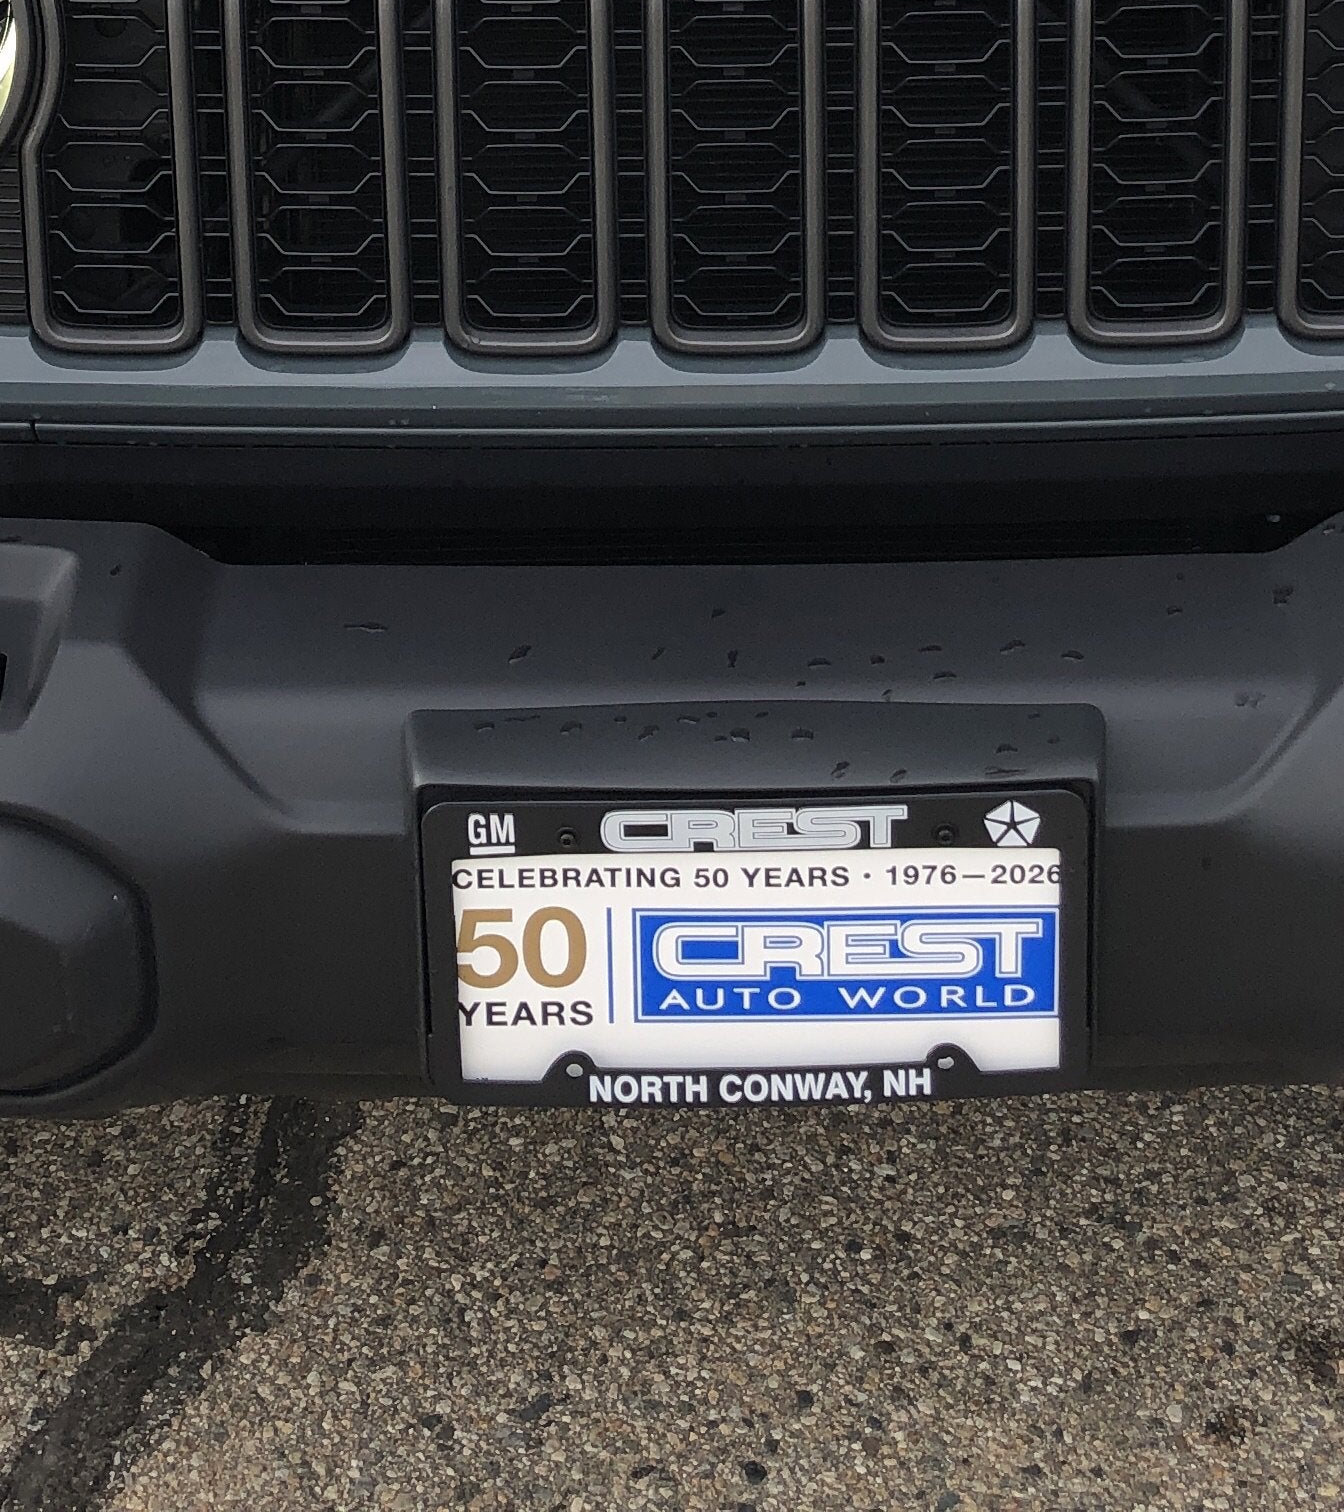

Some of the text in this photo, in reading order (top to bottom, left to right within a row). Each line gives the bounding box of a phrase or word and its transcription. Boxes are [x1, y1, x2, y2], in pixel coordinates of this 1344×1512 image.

[467, 813, 515, 846] GM
[600, 805, 908, 852] CREST
[451, 866, 681, 890] CELEBRATING
[693, 866, 730, 889] 50
[741, 866, 850, 888] YEARS
[456, 906, 587, 989] 50
[653, 918, 1043, 982] CREST
[458, 1001, 594, 1027] YEARS
[659, 984, 1037, 1011] AUTO WORLD
[588, 1067, 932, 1104] NORTH CONWAY, NH
